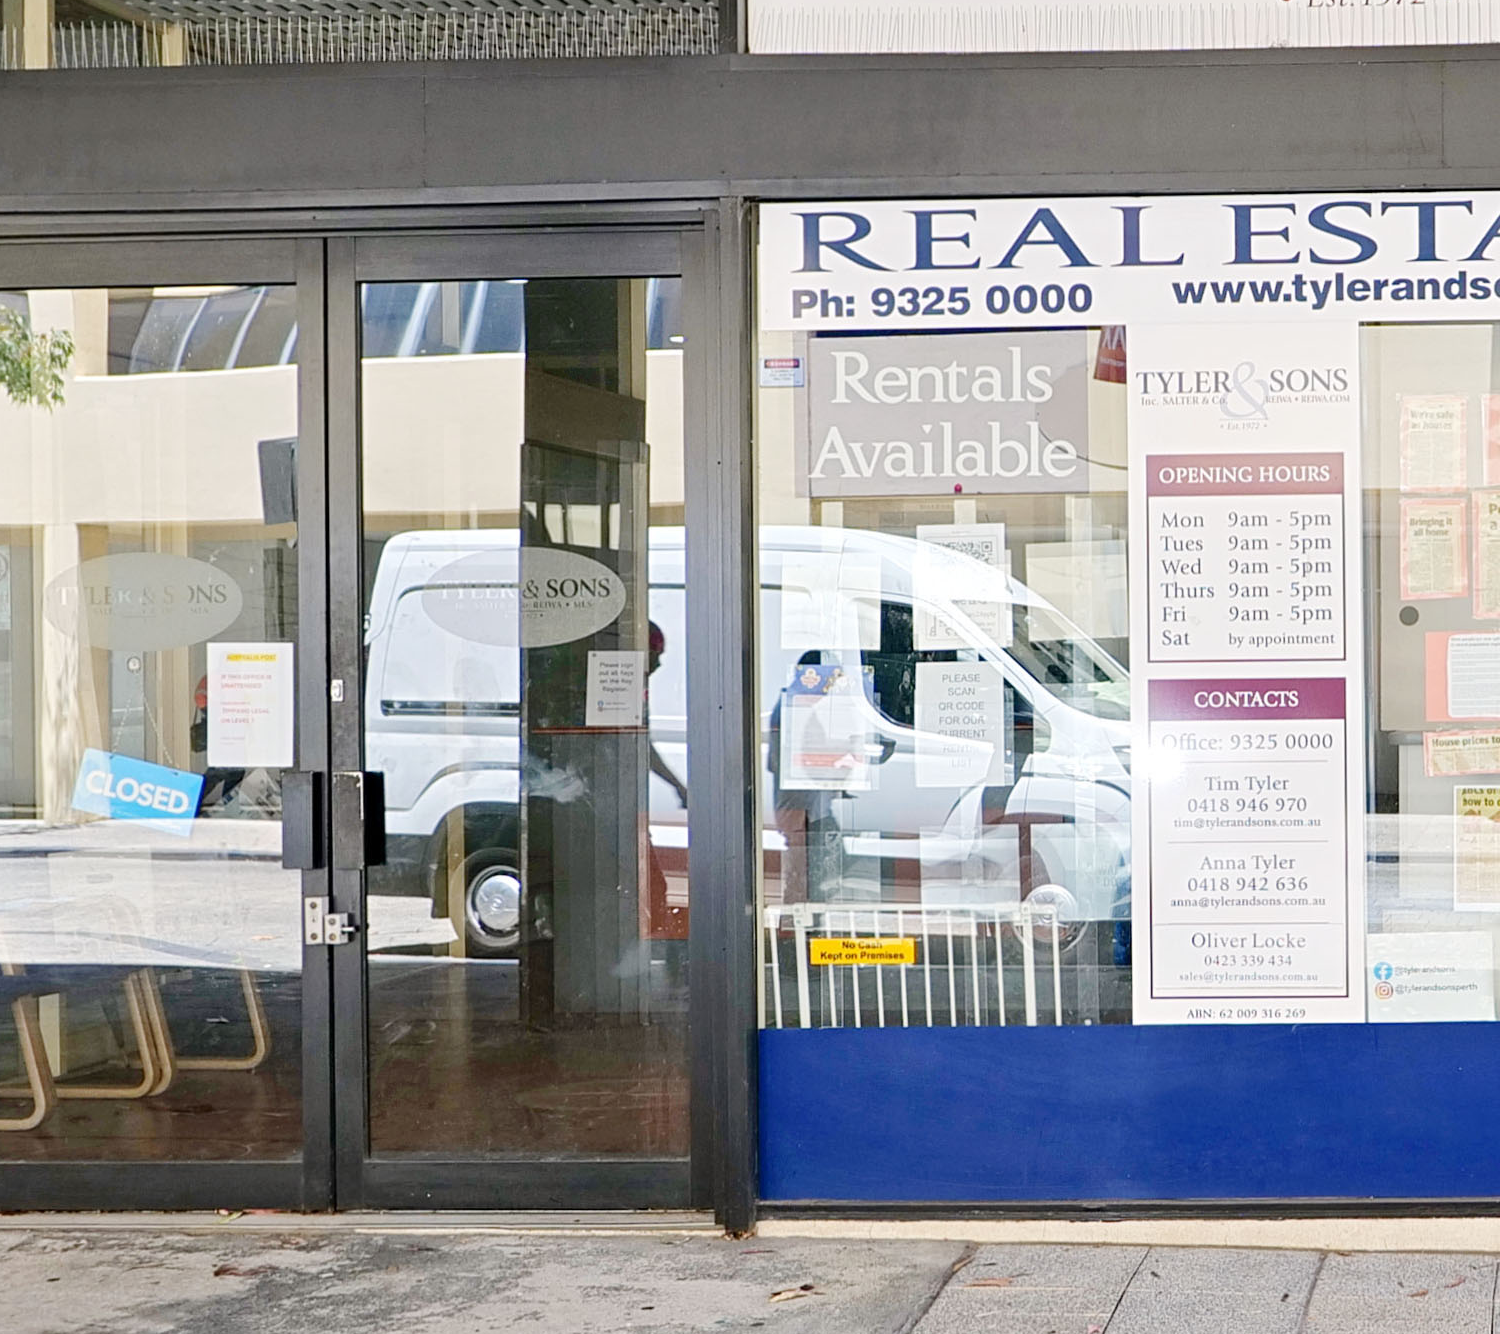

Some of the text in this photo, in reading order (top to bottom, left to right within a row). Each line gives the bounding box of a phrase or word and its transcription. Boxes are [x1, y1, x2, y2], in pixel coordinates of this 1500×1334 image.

[791, 204, 1184, 272] REAL
[791, 288, 856, 318] Ph:
[871, 285, 971, 317] 9325
[986, 283, 1094, 314] 0000
[831, 347, 1053, 403] Rentals
[1136, 361, 1348, 420] TYLER & SONS
[1162, 393, 1350, 406] SALTER REIWA REIWA.COM
[808, 422, 1078, 478] Available
[1159, 465, 1330, 484] OPENING HOURS
[1161, 510, 1332, 530] Mon 9am 5pm
[1160, 534, 1332, 554] Tues 9am 5pm
[1161, 557, 1332, 577] Wed 9am 5pm
[546, 578, 610, 598] SONS
[1160, 581, 1332, 601] Thurs 9am 5pm
[1162, 604, 1332, 624] Fri 9am 5pm
[1161, 629, 1335, 649] Sat by appointment
[942, 674, 980, 683] PLEASE
[947, 687, 976, 697] SCAN
[1195, 690, 1300, 708] CONTACTS
[955, 701, 985, 711] CODE
[939, 716, 960, 726] FOR
[1162, 733, 1333, 750] Office: 9325 0000
[1432, 736, 1460, 748] House
[1462, 735, 1489, 749] prices
[1491, 735, 1500, 744] to
[85, 770, 189, 814] CLOSED
[1204, 775, 1290, 794] Tim Tyler
[1187, 797, 1307, 812] 0418 946 970
[1173, 817, 1321, 830] tim@tylerandsons.com.au
[1200, 854, 1296, 874] Anna Tyler
[1187, 876, 1308, 891] 0418 942 636
[1170, 896, 1326, 909] anna@tylerandsons.com.au
[842, 941, 883, 950] No Cash
[1191, 933, 1307, 948] Oliver Locke
[820, 951, 905, 961] Kept on Premises
[1204, 955, 1292, 966] 0423 339 434
[1179, 971, 1318, 984] sales@tylerandsons.com.au
[1394, 983, 1478, 995] @tylerandsonsperth
[1186, 1008, 1306, 1019] ABN: 62 009 316 269
